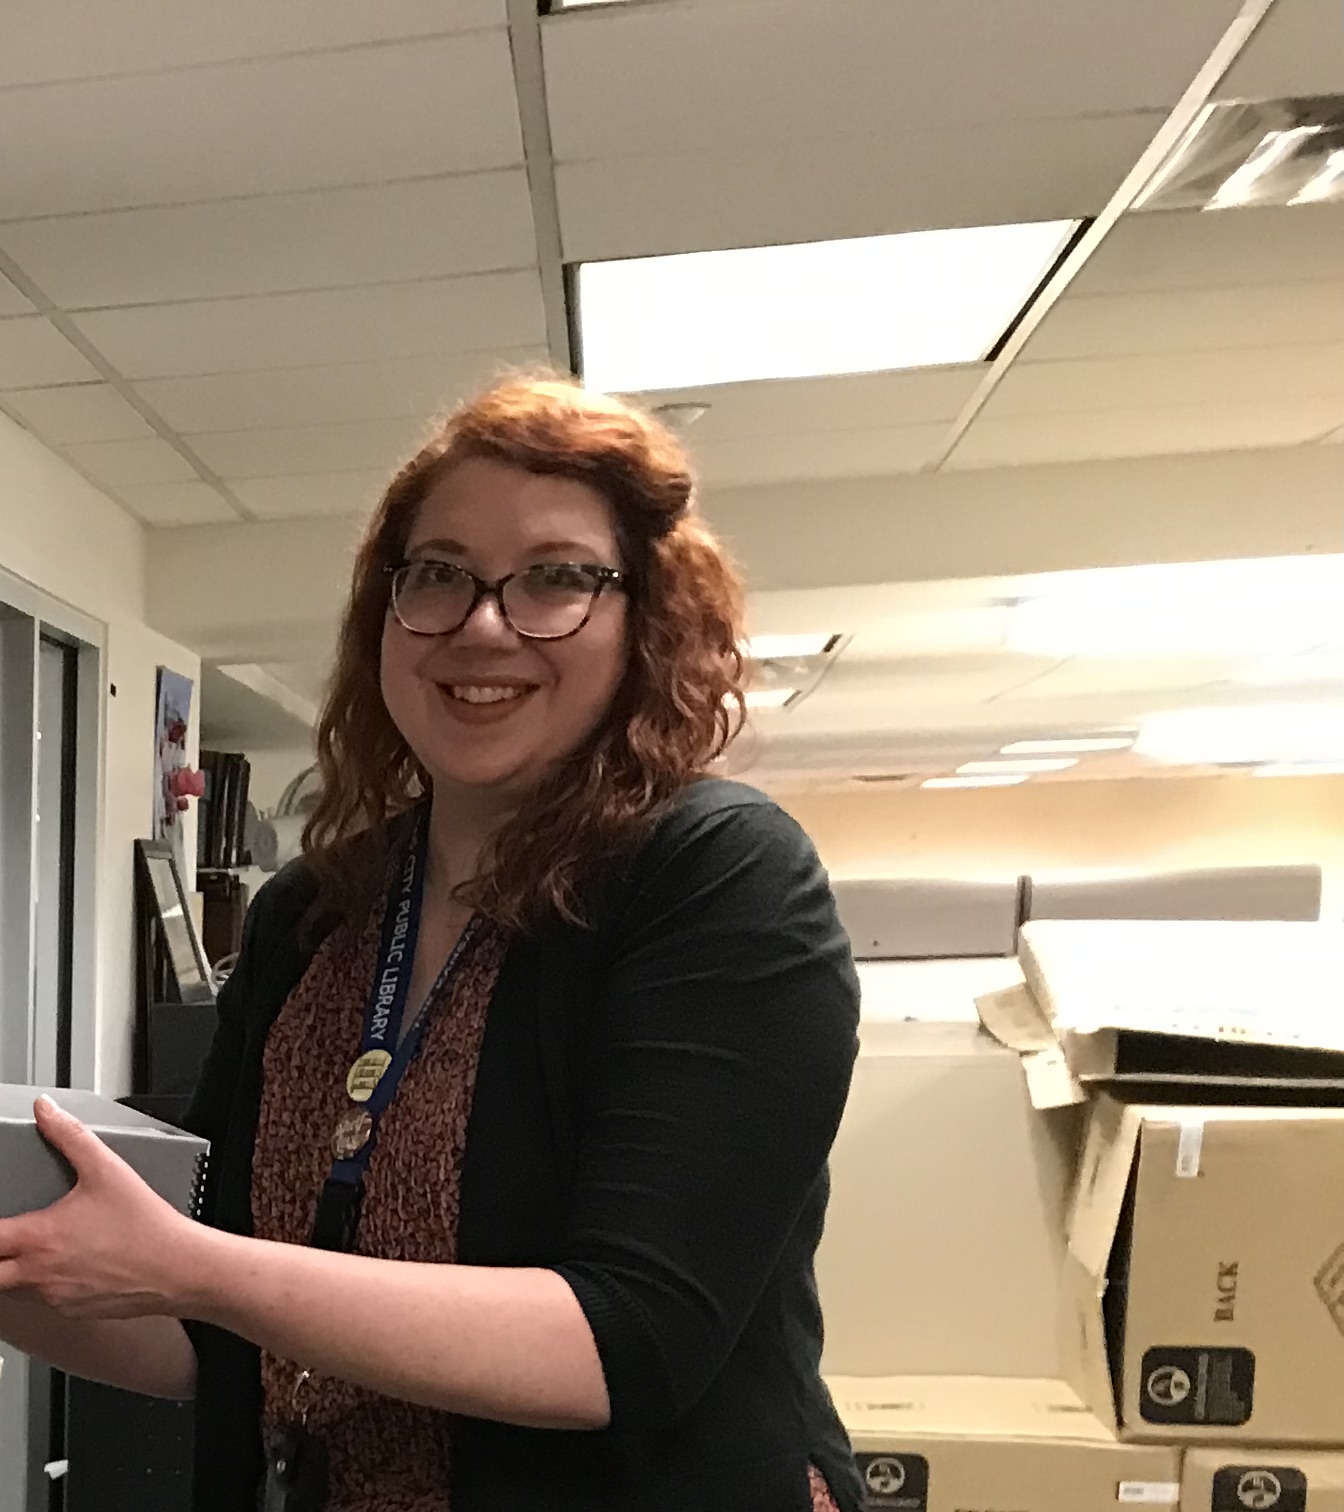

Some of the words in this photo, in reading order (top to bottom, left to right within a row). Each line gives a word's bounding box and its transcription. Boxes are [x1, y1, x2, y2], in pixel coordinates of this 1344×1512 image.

[387, 899, 411, 963] PUBLIC
[370, 968, 400, 1041] LIBRARY
[1214, 1261, 1239, 1322] BACK
